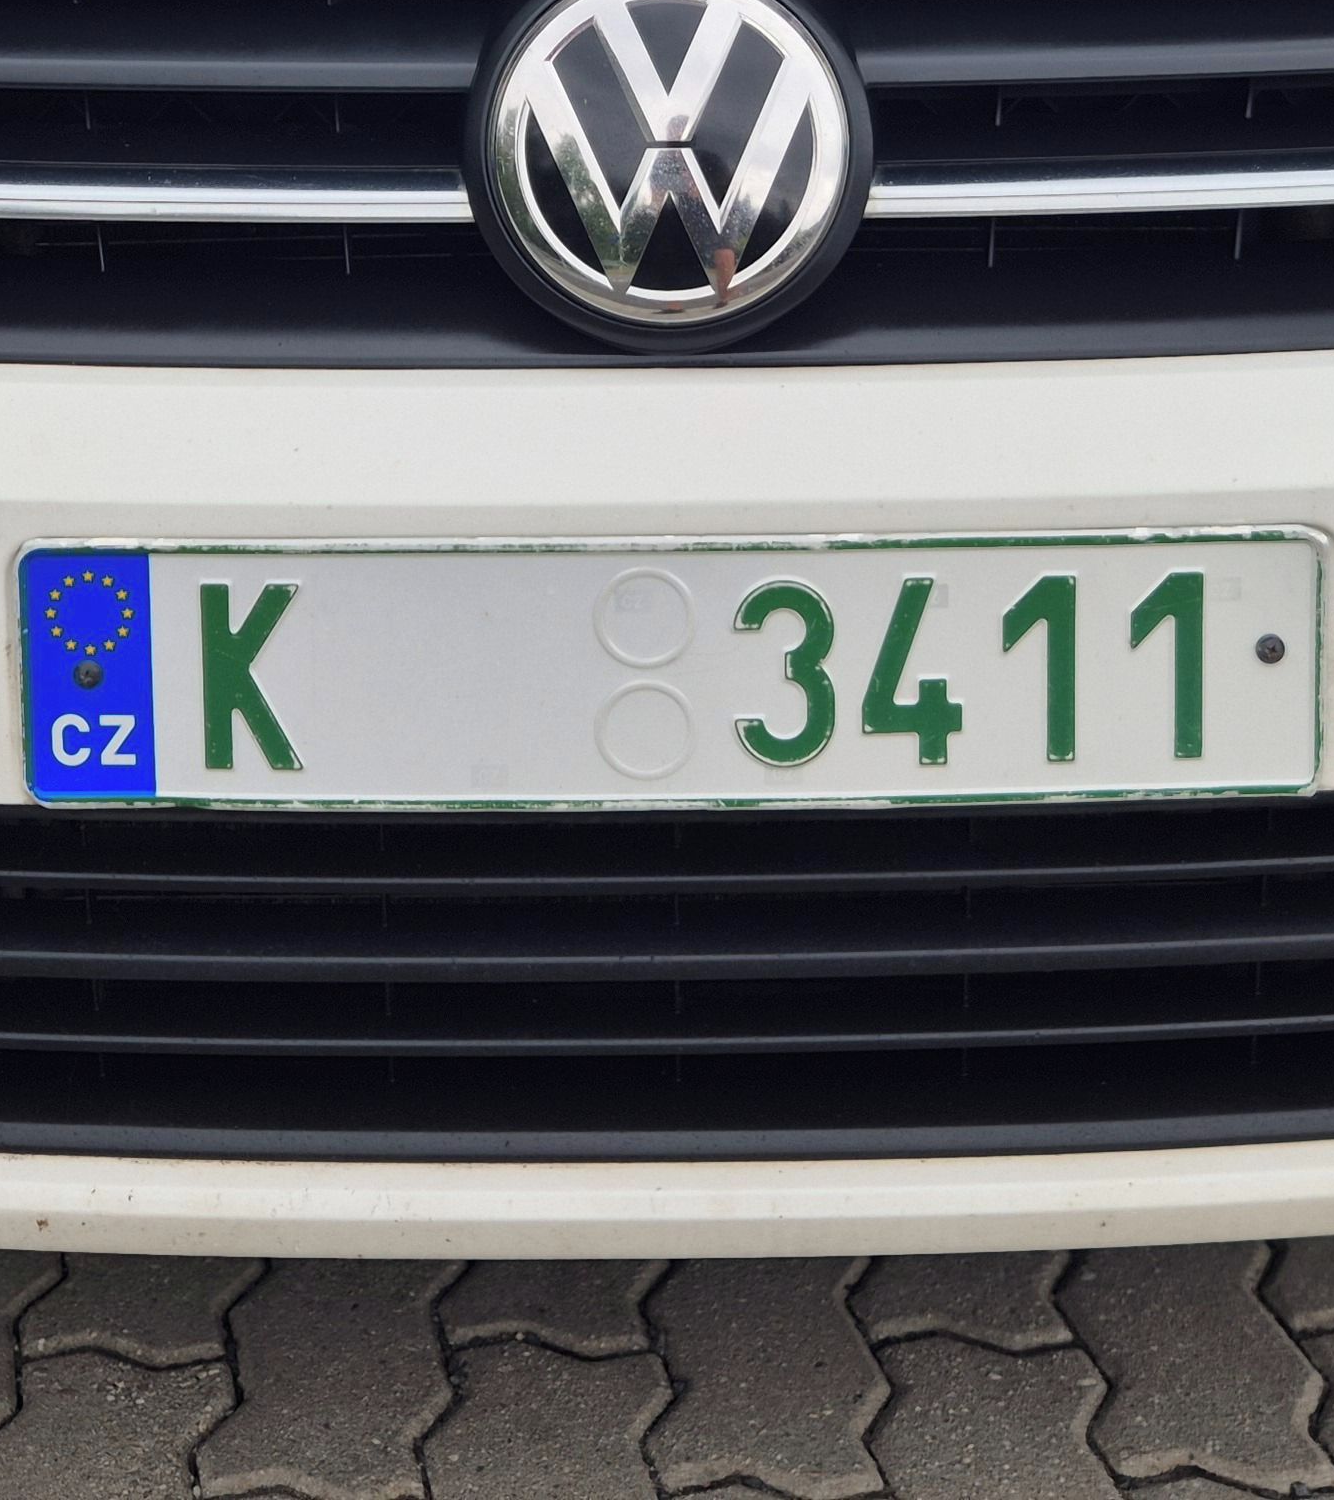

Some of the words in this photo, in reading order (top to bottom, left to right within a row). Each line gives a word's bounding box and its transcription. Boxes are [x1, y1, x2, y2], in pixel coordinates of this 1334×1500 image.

[199, 581, 304, 771] K
[733, 571, 1205, 768] 3411
[51, 713, 137, 767] CZ
